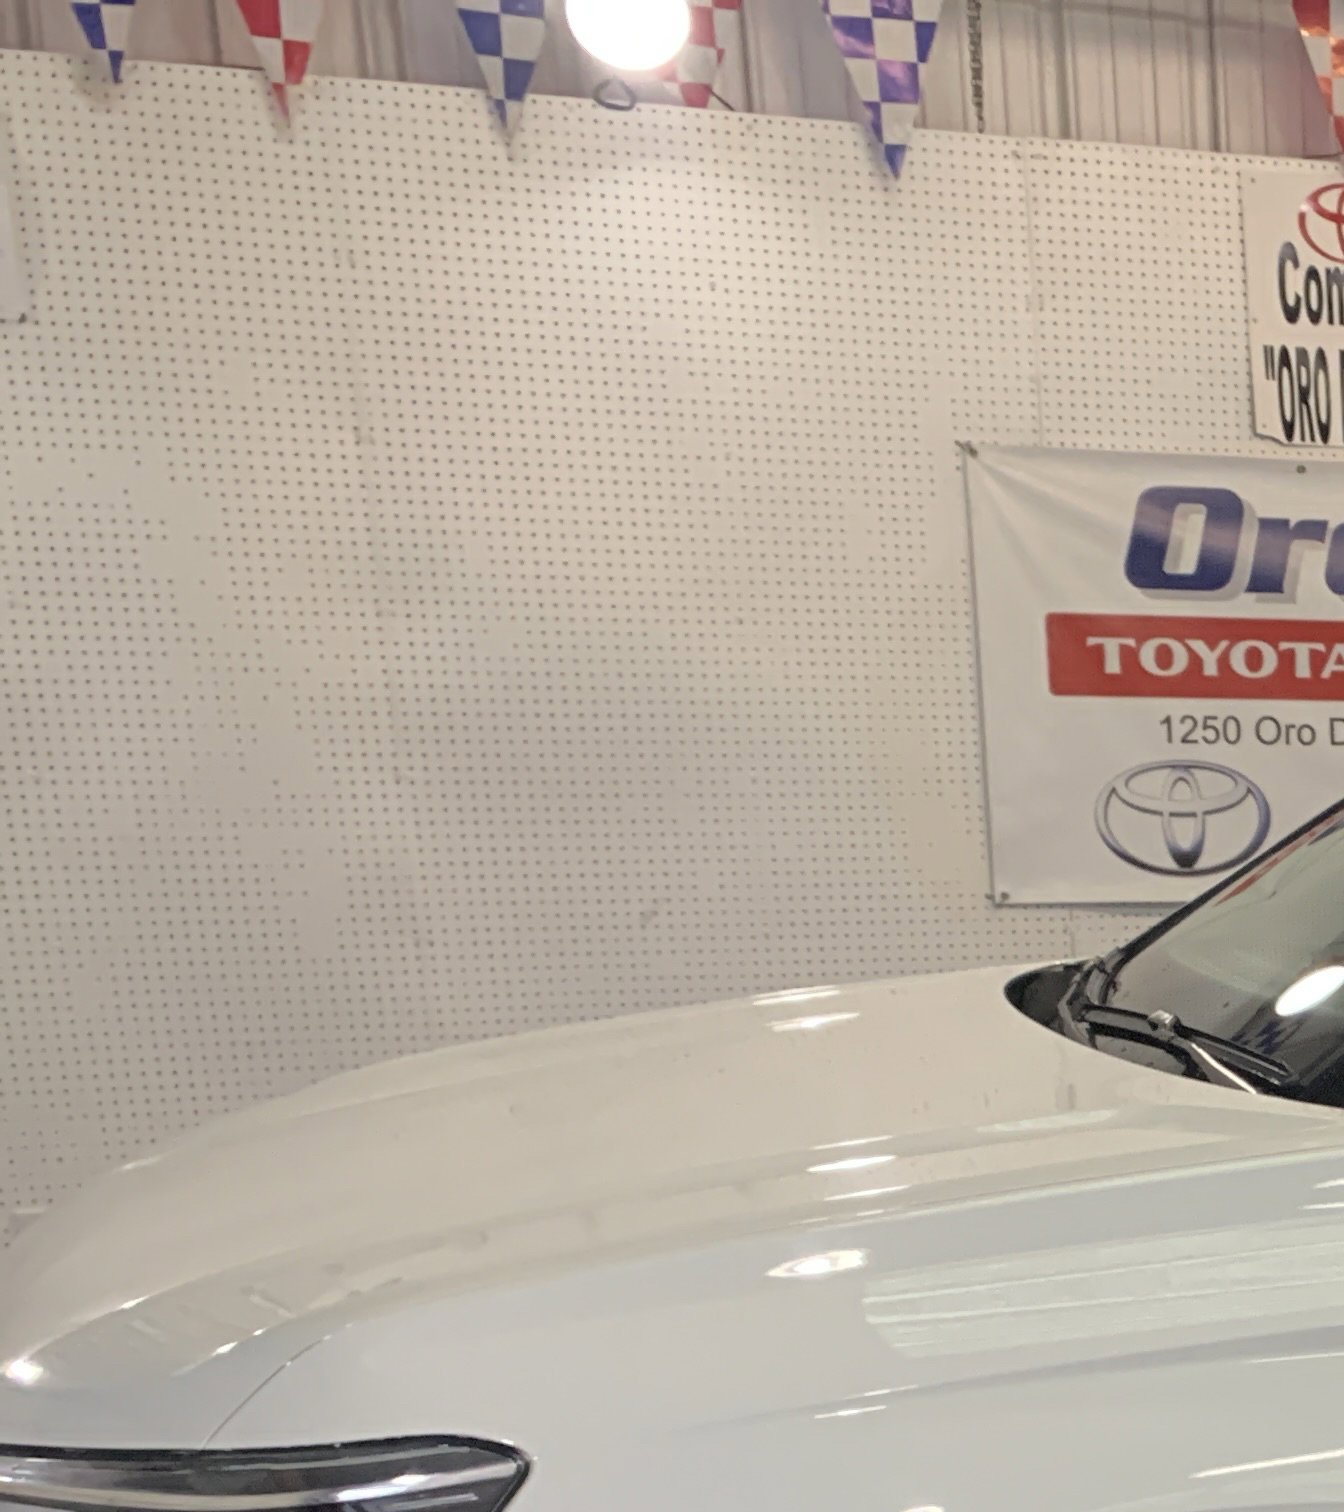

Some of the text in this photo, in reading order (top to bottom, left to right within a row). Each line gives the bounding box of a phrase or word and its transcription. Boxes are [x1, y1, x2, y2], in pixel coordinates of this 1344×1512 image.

[1263, 344, 1331, 444] "ORO
[1160, 714, 1242, 745] 1250
[1255, 716, 1317, 747] Oro
